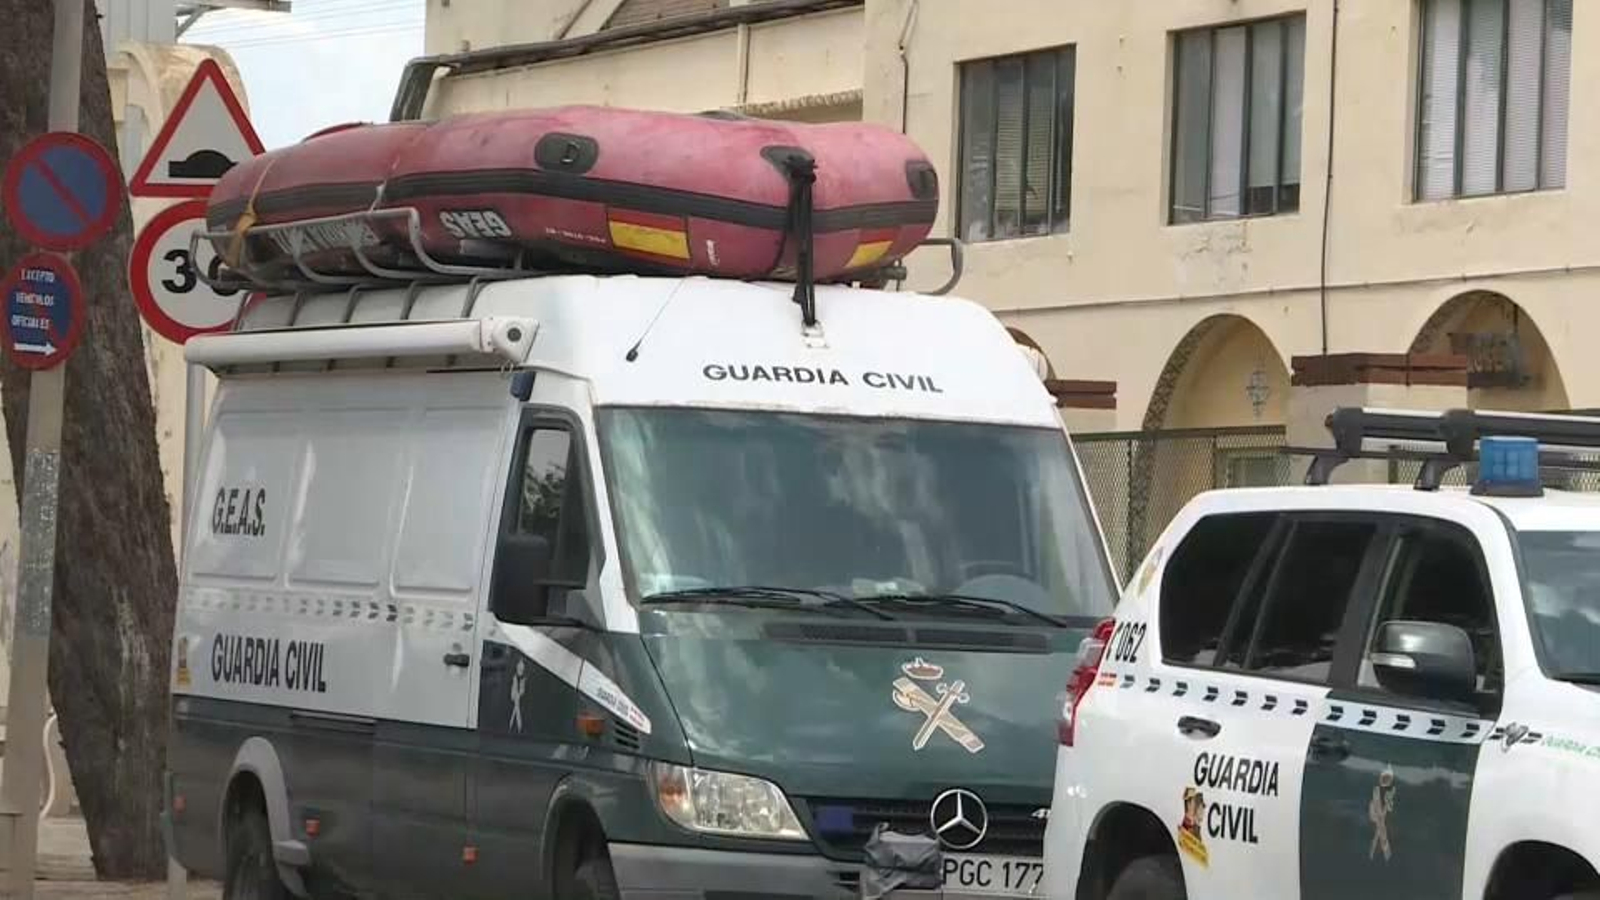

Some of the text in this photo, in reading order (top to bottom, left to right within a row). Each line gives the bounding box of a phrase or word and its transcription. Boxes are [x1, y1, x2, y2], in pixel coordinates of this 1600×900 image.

[439, 209, 512, 238] GEAS
[703, 364, 944, 393] GUARDIA CIVIL
[212, 487, 266, 536] G.E.A.S.
[211, 632, 327, 693] GUARDIA CIVIL
[1115, 622, 1147, 663] 062
[1194, 751, 1279, 797] GUARDIA
[1207, 802, 1259, 844] CIVIL
[943, 859, 1044, 888] PGC 177
